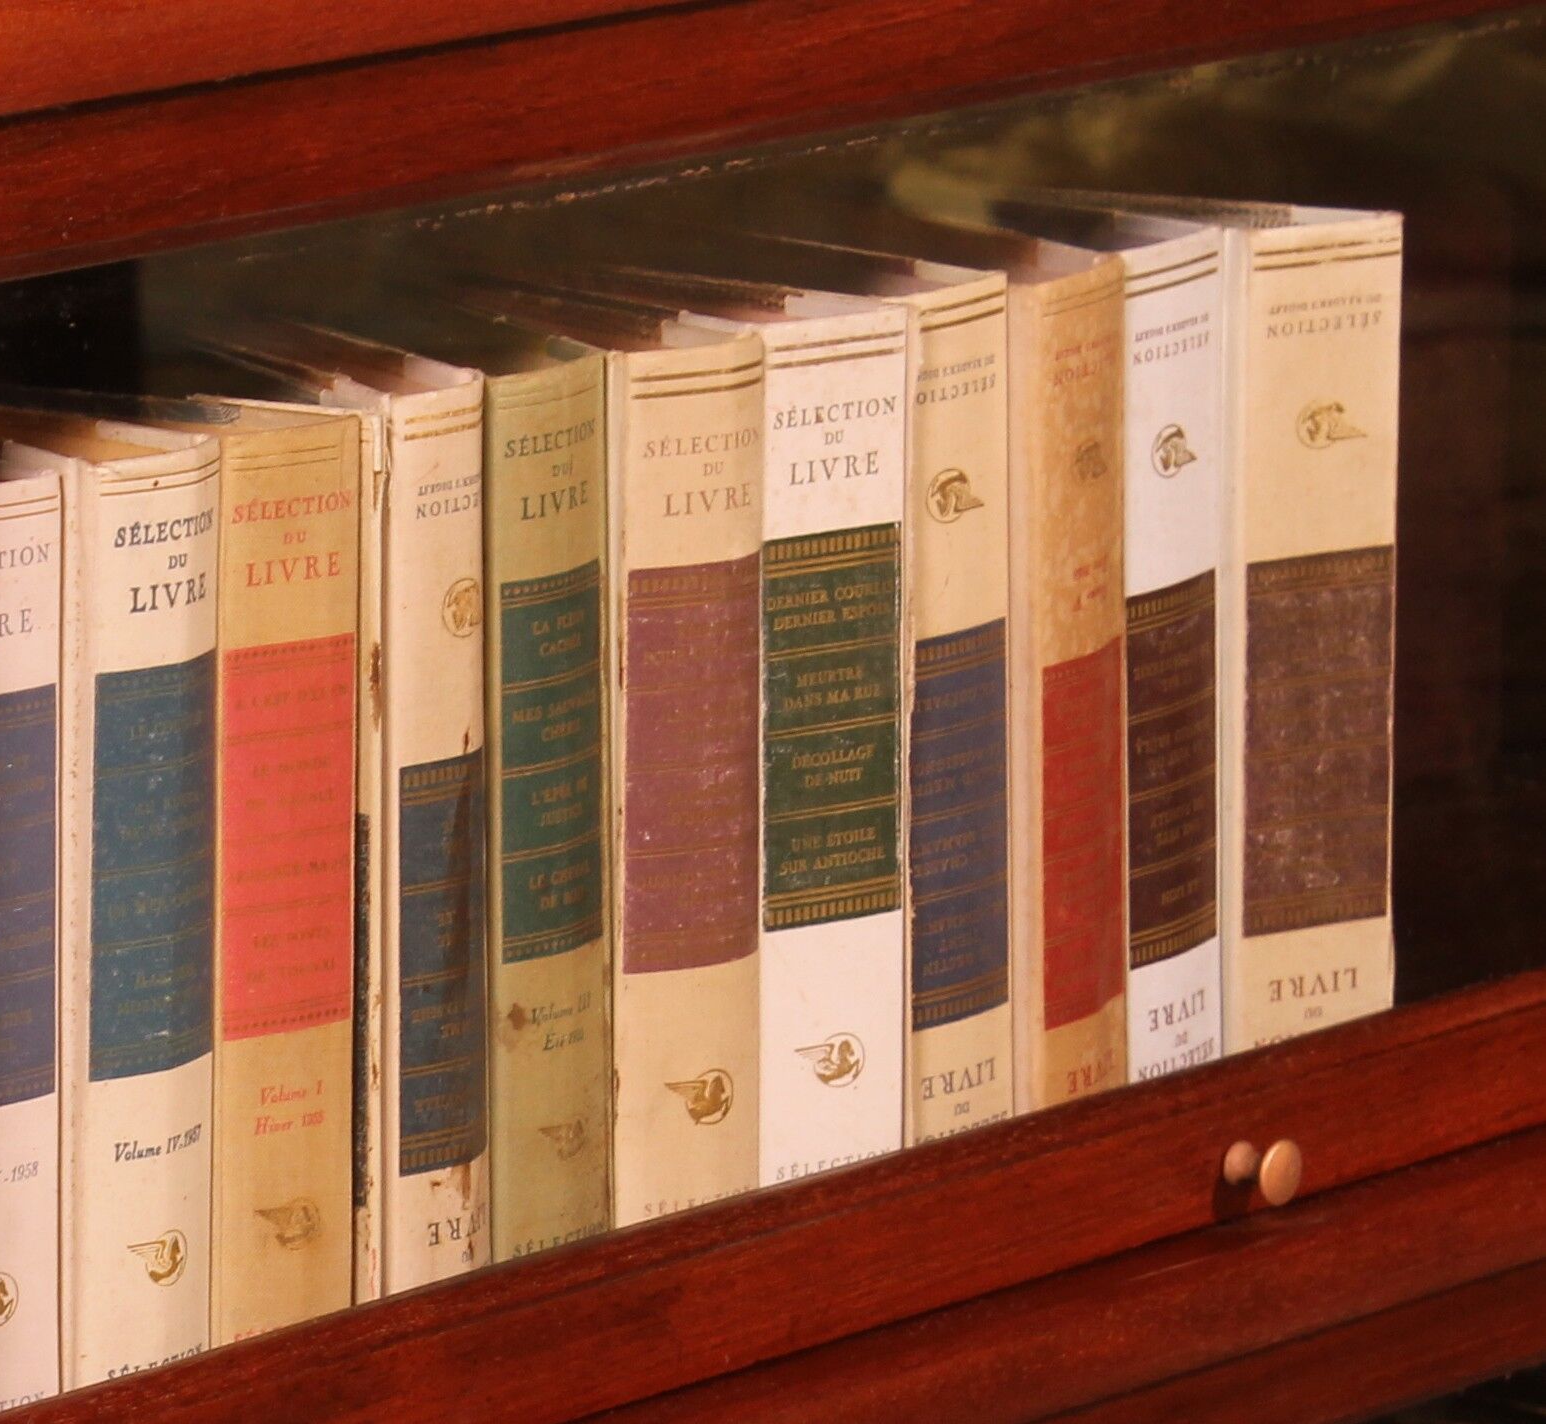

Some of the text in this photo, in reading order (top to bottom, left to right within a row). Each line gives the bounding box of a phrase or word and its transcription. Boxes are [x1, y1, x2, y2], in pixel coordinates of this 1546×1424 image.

[915, 373, 997, 405] SÉLECTIO
[772, 396, 898, 431] SÉLECTION
[503, 418, 597, 459] SÉLECTION
[824, 429, 846, 446] DU
[703, 461, 724, 477] DU
[789, 451, 880, 487] LIVRE
[231, 491, 352, 525] SÉLECTION
[519, 480, 589, 521] LIVRE
[662, 483, 752, 518] LIVRE
[113, 507, 215, 548] SÉLECTION
[282, 531, 307, 546] DU
[167, 553, 189, 571] DU
[245, 551, 342, 588] LIVRE
[129, 572, 206, 614] LIVRE
[1268, 968, 1358, 1002] LIVRE
[1147, 989, 1205, 1033] LIVRE
[920, 1057, 996, 1100] LIVRE
[114, 1140, 162, 1162] Volume
